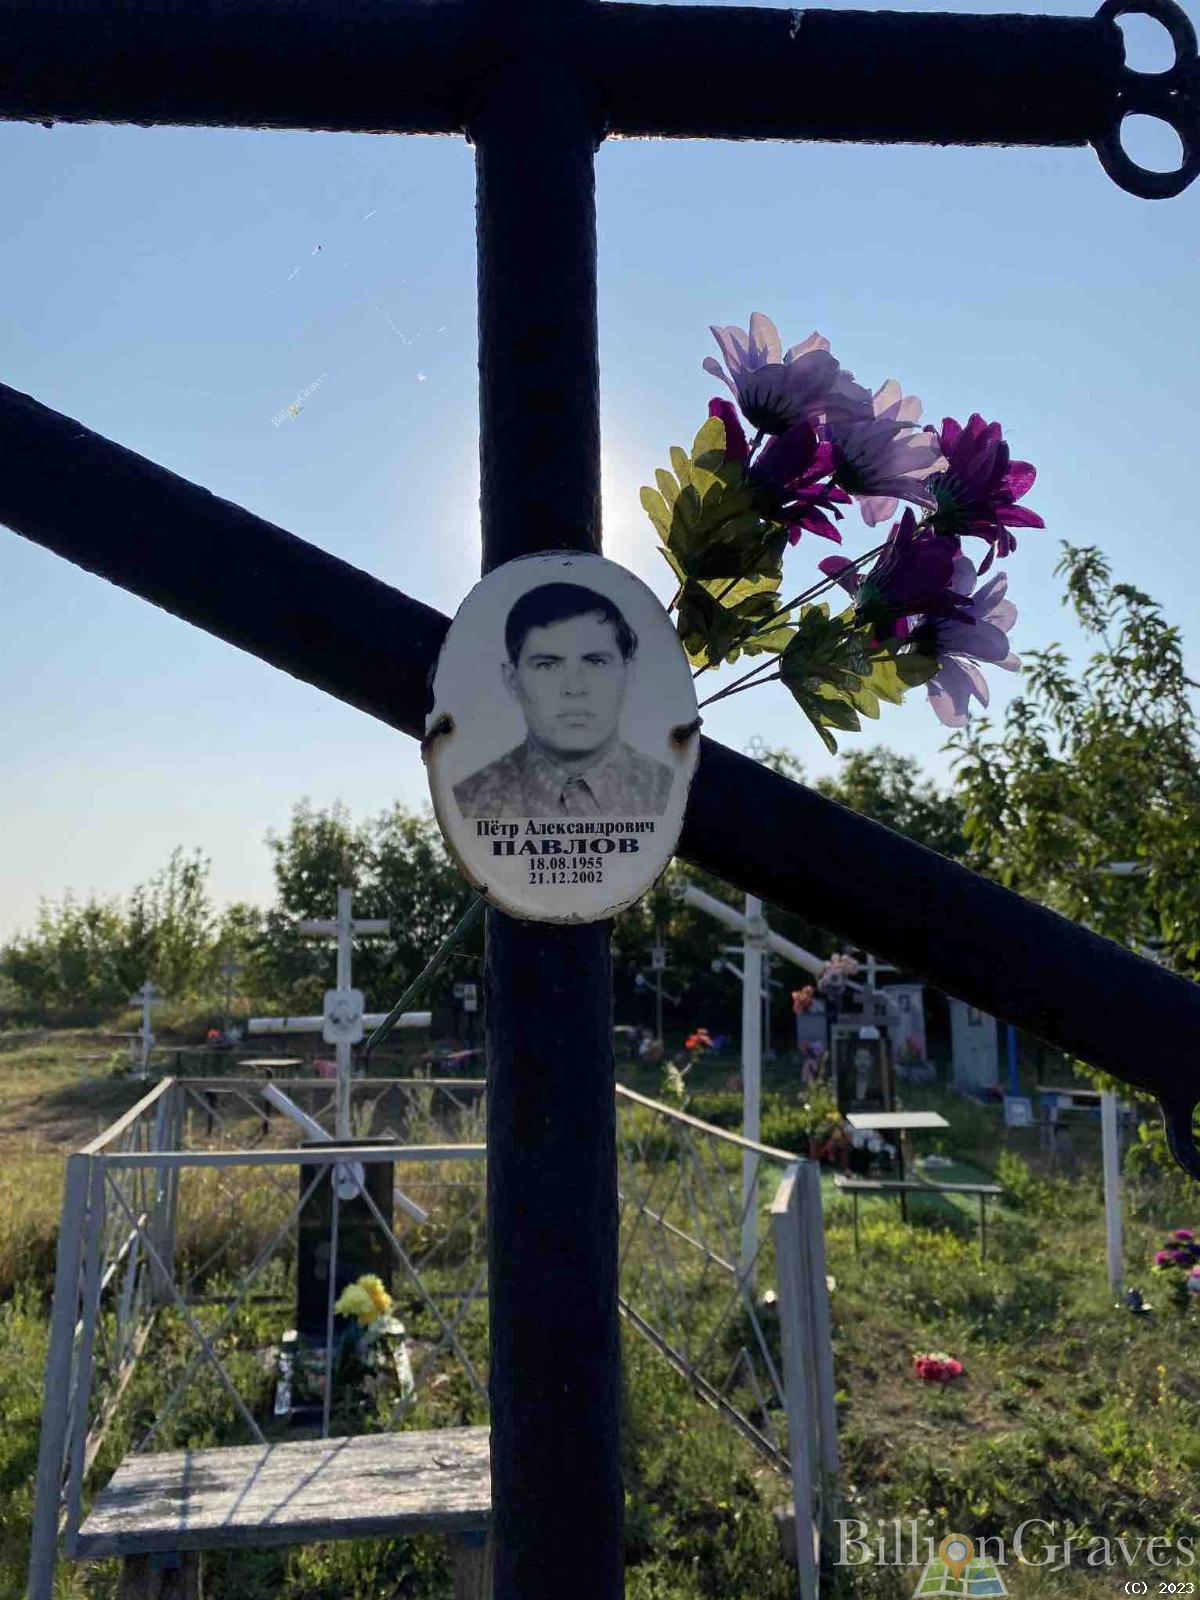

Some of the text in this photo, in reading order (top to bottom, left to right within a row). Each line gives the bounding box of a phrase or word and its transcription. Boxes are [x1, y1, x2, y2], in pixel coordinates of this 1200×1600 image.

[477, 819, 655, 838] Пётр Александрович
[492, 838, 640, 856] ПАВЛОВ
[529, 856, 603, 871] 18.08.1955
[529, 871, 603, 885] 21.12.2002
